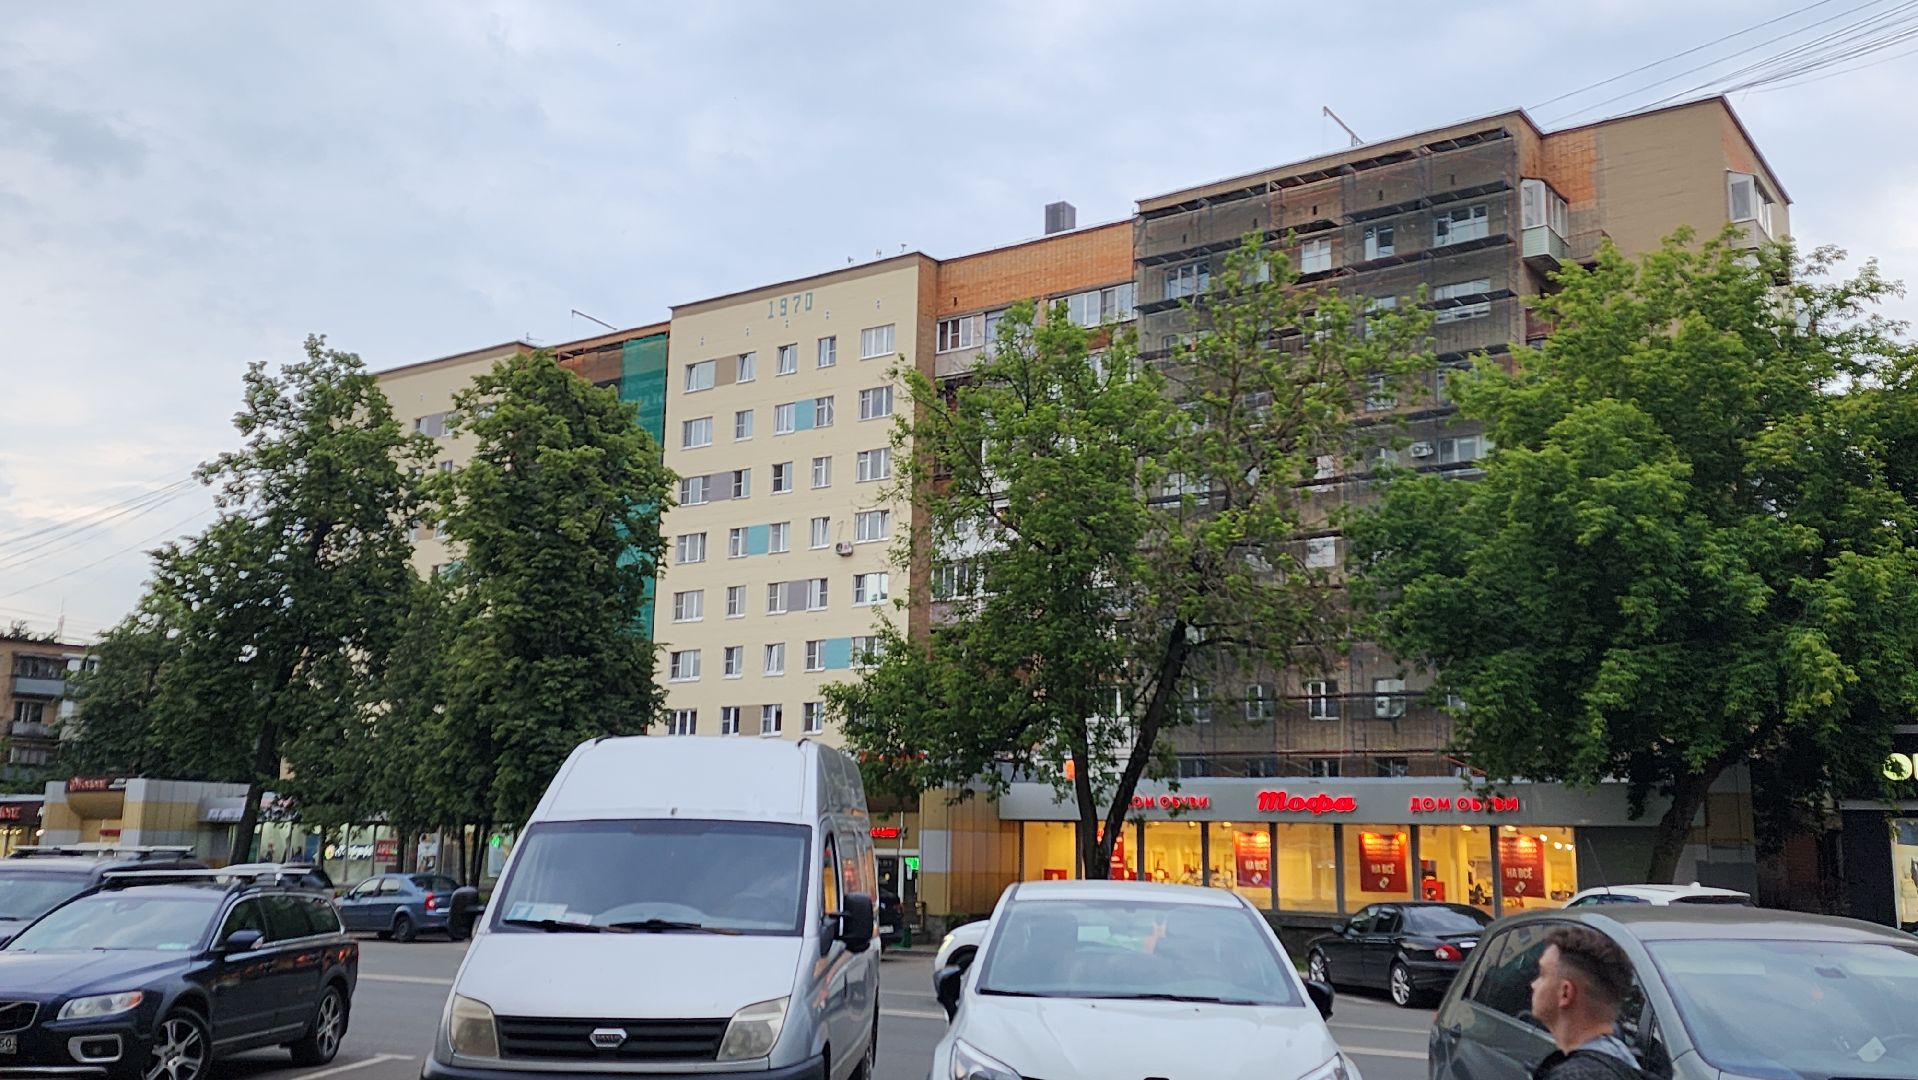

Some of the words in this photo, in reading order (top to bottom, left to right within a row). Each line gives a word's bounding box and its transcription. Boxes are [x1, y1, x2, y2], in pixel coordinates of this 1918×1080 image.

[768, 292, 813, 319] 1970
[1409, 796, 1451, 812] ДОМ
[1456, 796, 1519, 812] ОБВИ
